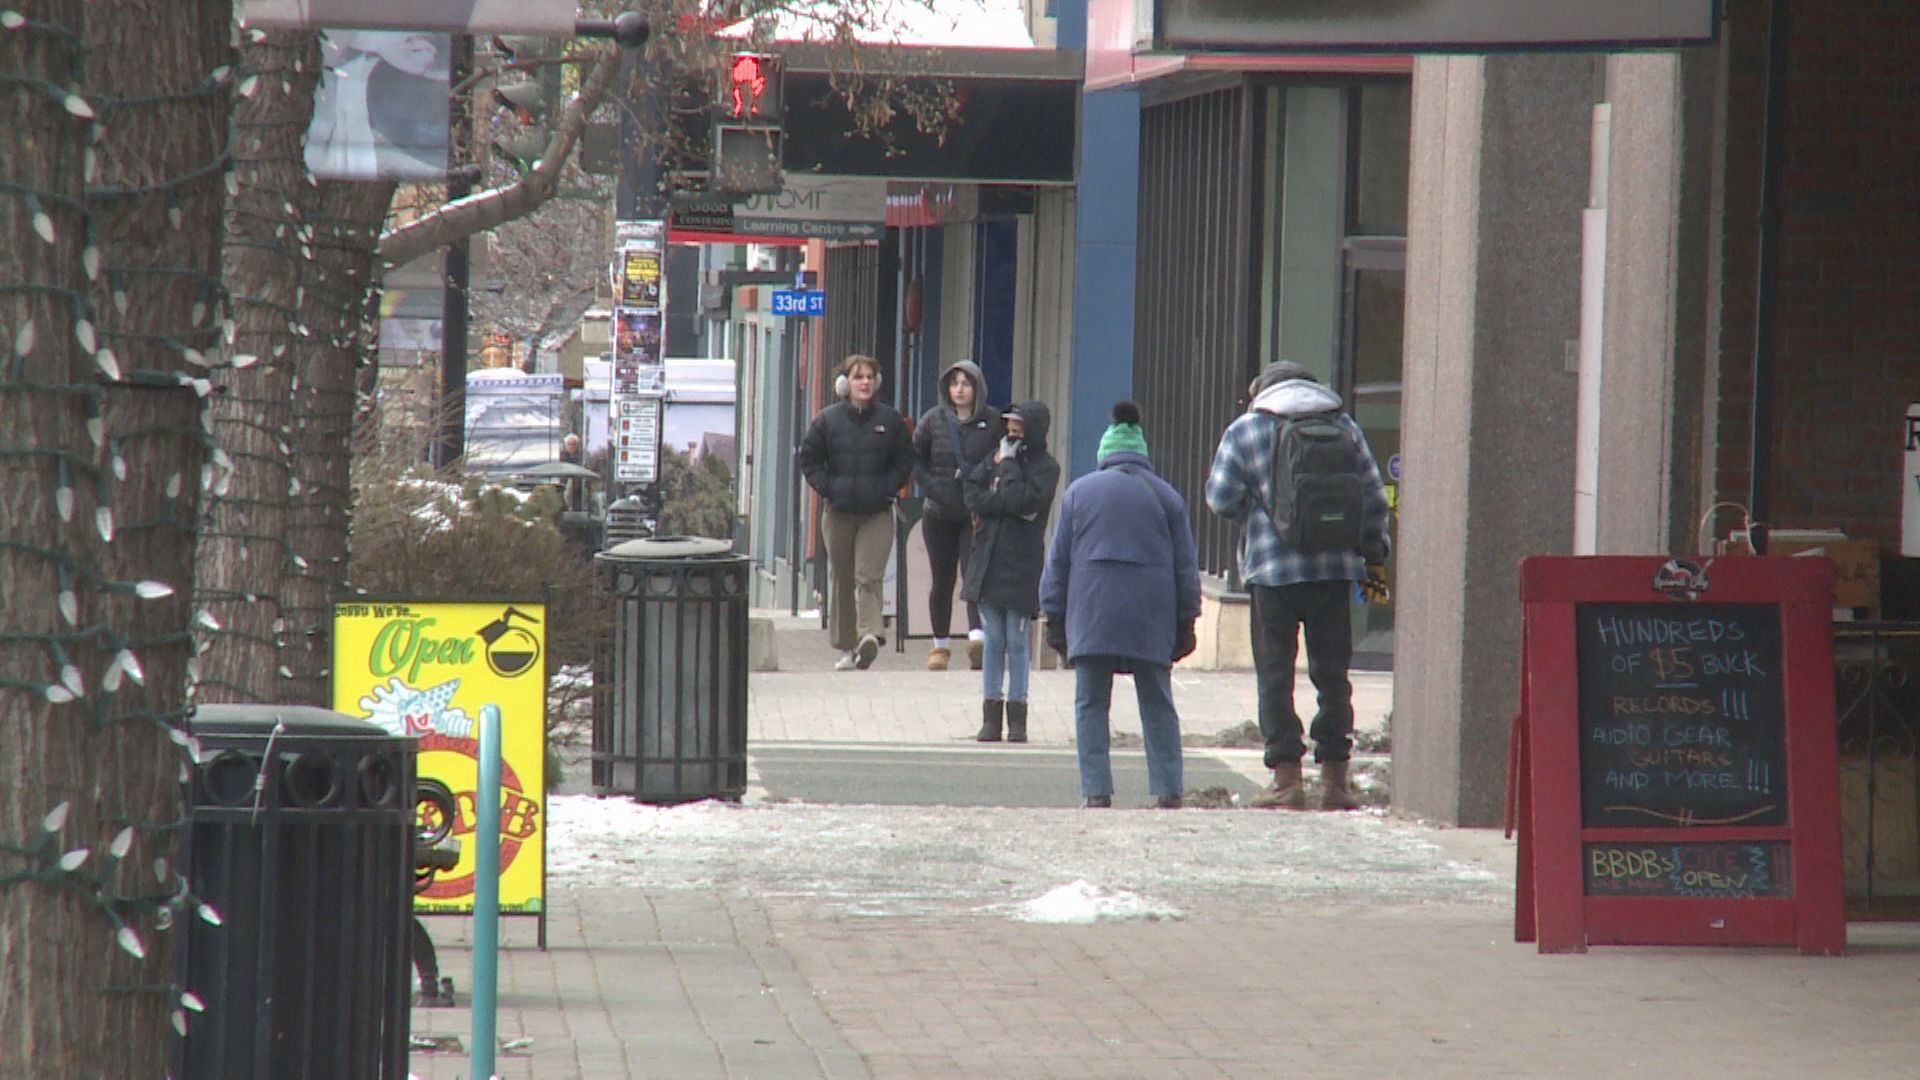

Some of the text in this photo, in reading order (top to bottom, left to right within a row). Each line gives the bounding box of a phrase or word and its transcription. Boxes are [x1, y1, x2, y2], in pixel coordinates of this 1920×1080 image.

[743, 221, 845, 234] Learning Centre
[776, 294, 823, 312] 33rd ST
[1598, 616, 1745, 647] HUNDREDS
[369, 617, 475, 684] Open
[1612, 647, 1766, 681] OF $5 BUCK
[1663, 723, 1733, 747] GEAR
[1630, 748, 1733, 767] GUITARS
[1605, 770, 1650, 790] AND
[1683, 867, 1748, 889] OPEN
